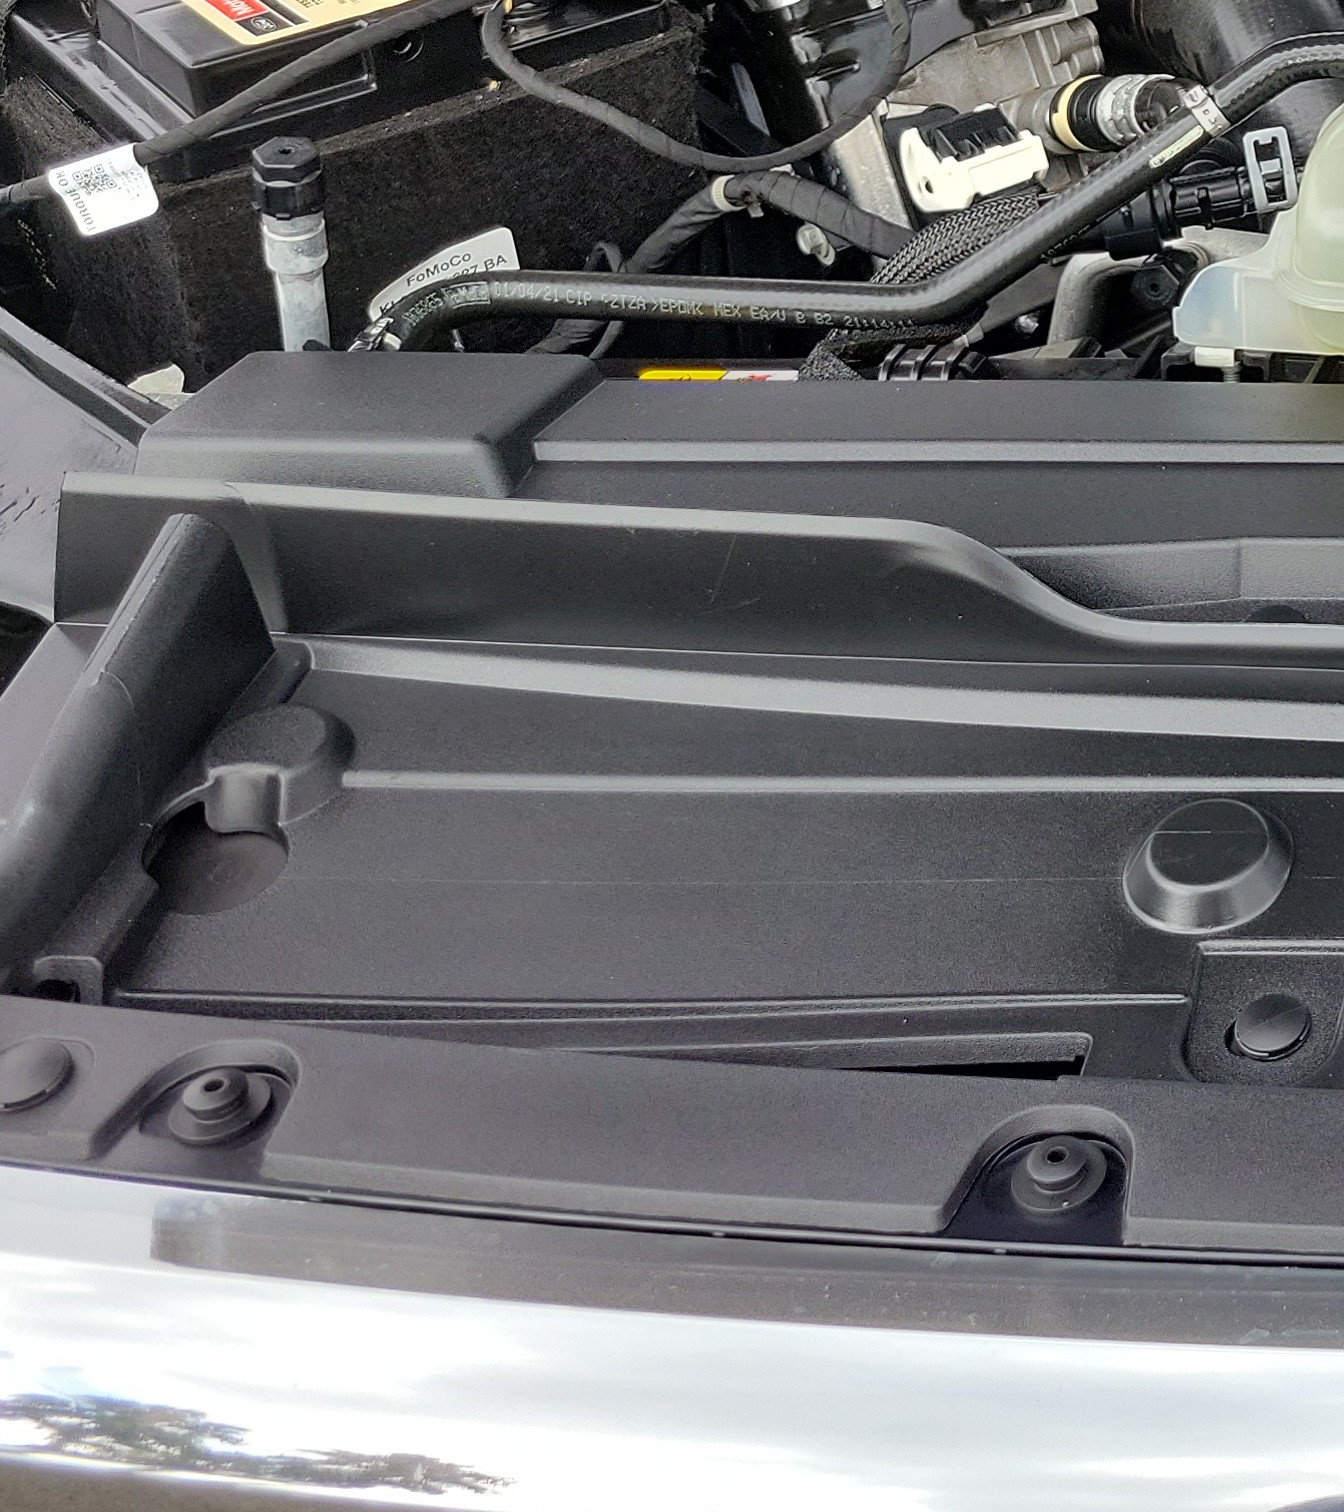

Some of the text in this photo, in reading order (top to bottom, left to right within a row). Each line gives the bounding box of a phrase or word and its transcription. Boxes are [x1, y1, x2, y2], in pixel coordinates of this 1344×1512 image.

[56, 170, 69, 187] OK
[406, 252, 472, 287] FoMoCo
[484, 254, 508, 272] BA
[494, 281, 560, 303] 01/04/21
[714, 301, 743, 318] MEX
